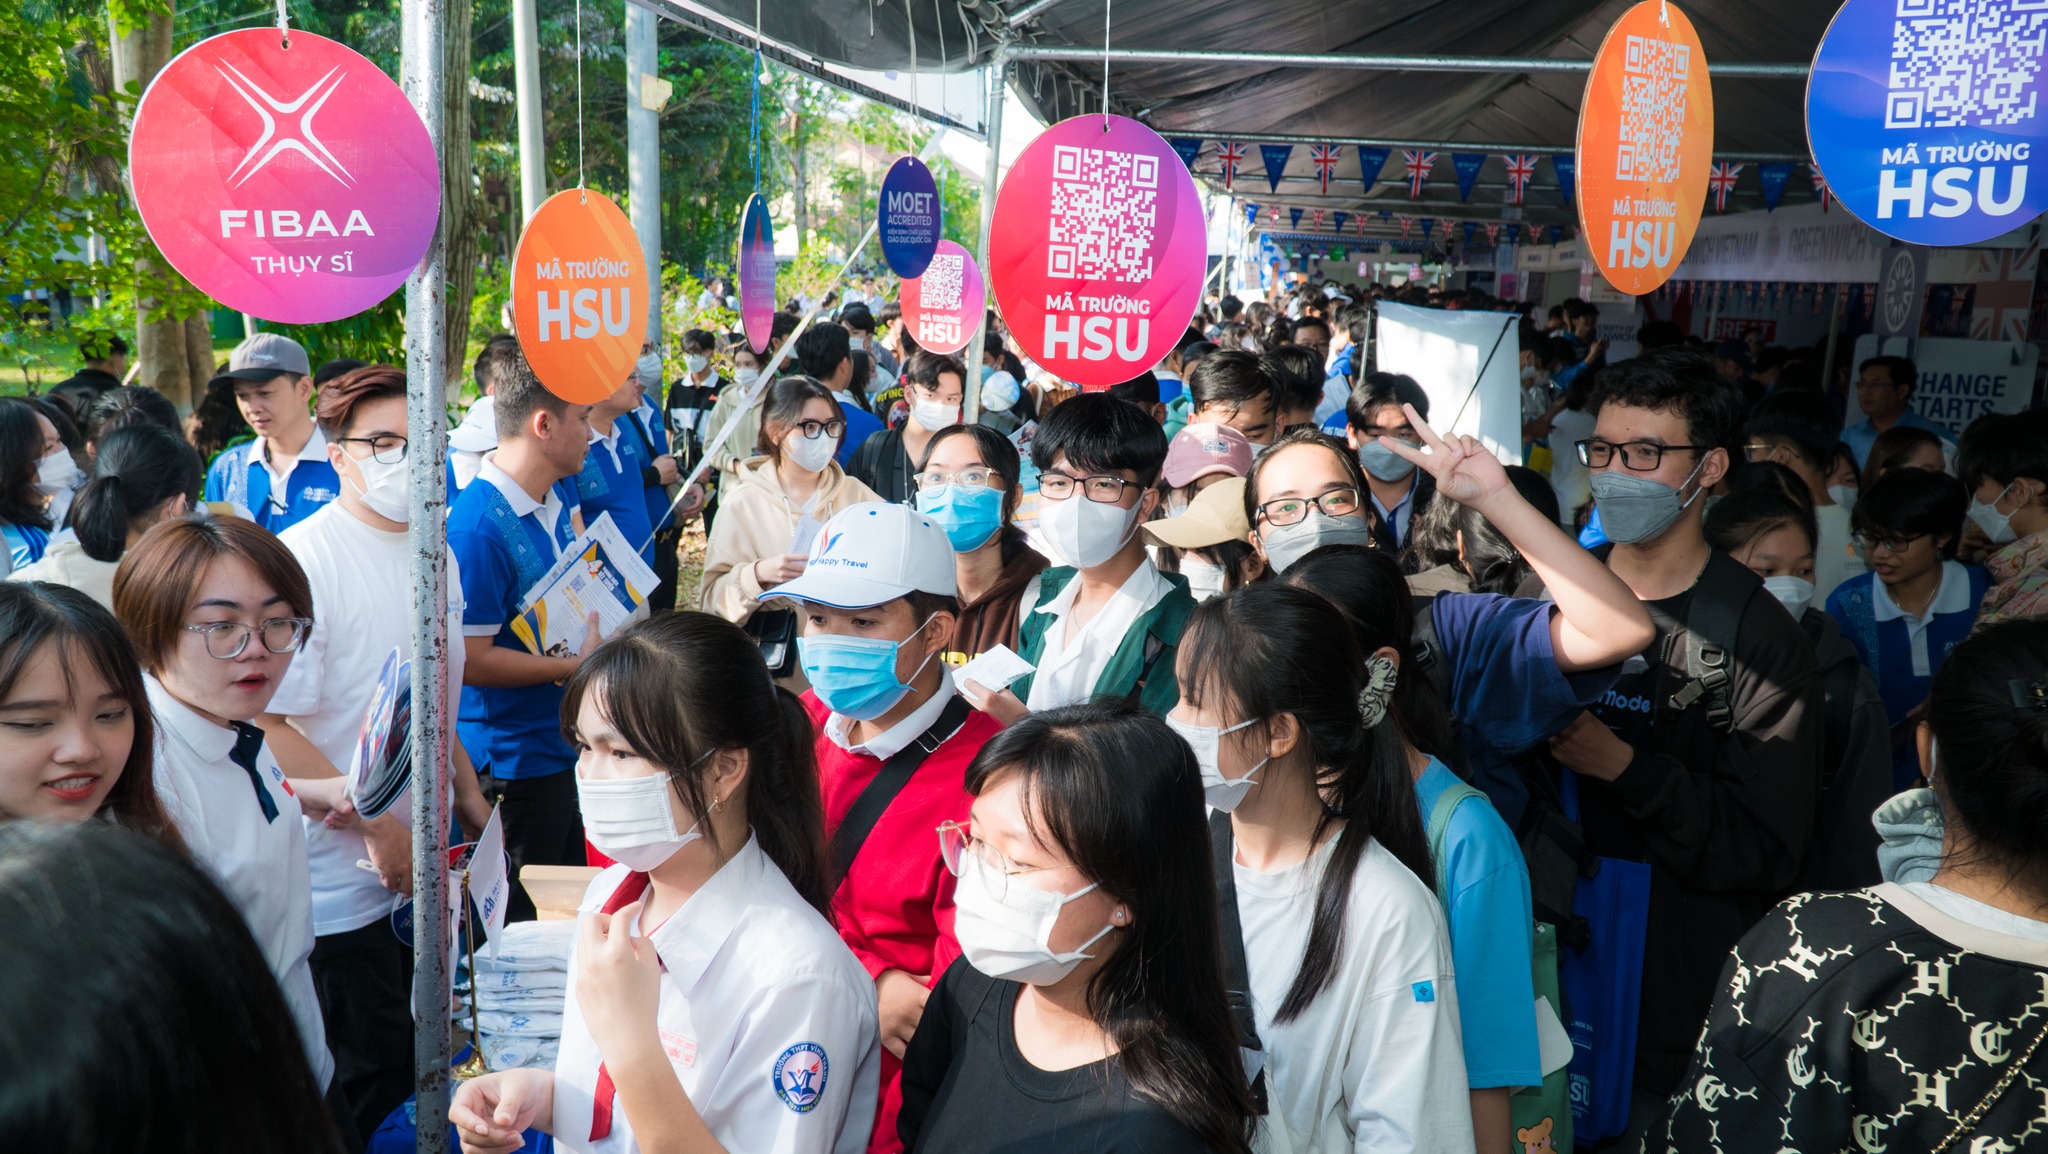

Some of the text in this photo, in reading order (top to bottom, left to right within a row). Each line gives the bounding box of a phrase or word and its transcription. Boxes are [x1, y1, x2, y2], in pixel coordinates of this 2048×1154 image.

[1882, 141, 2030, 165] MÃ TRƯỜNG
[888, 191, 933, 214] MOET
[1877, 165, 2028, 219] HSU
[1613, 197, 1676, 217] MÃ TRƯỜNG
[220, 209, 375, 238] FIBAA
[887, 215, 932, 226] ACCREDITED
[1608, 220, 1676, 268] HSU
[251, 251, 353, 278] THỤY SĨ
[536, 257, 630, 280] MÃ TRƯỜNG
[538, 287, 631, 342] HSU
[1046, 291, 1150, 315] MÃ TRƯỜNG
[920, 312, 961, 325] MÃ TRƯỜNG
[1713, 319, 1772, 340] GRET
[919, 322, 961, 345] HSU
[1043, 314, 1150, 362] HSU
[1915, 372, 2008, 397] HANGE
[842, 558, 869, 568] Travel
[1569, 1082, 1590, 1106] SU
